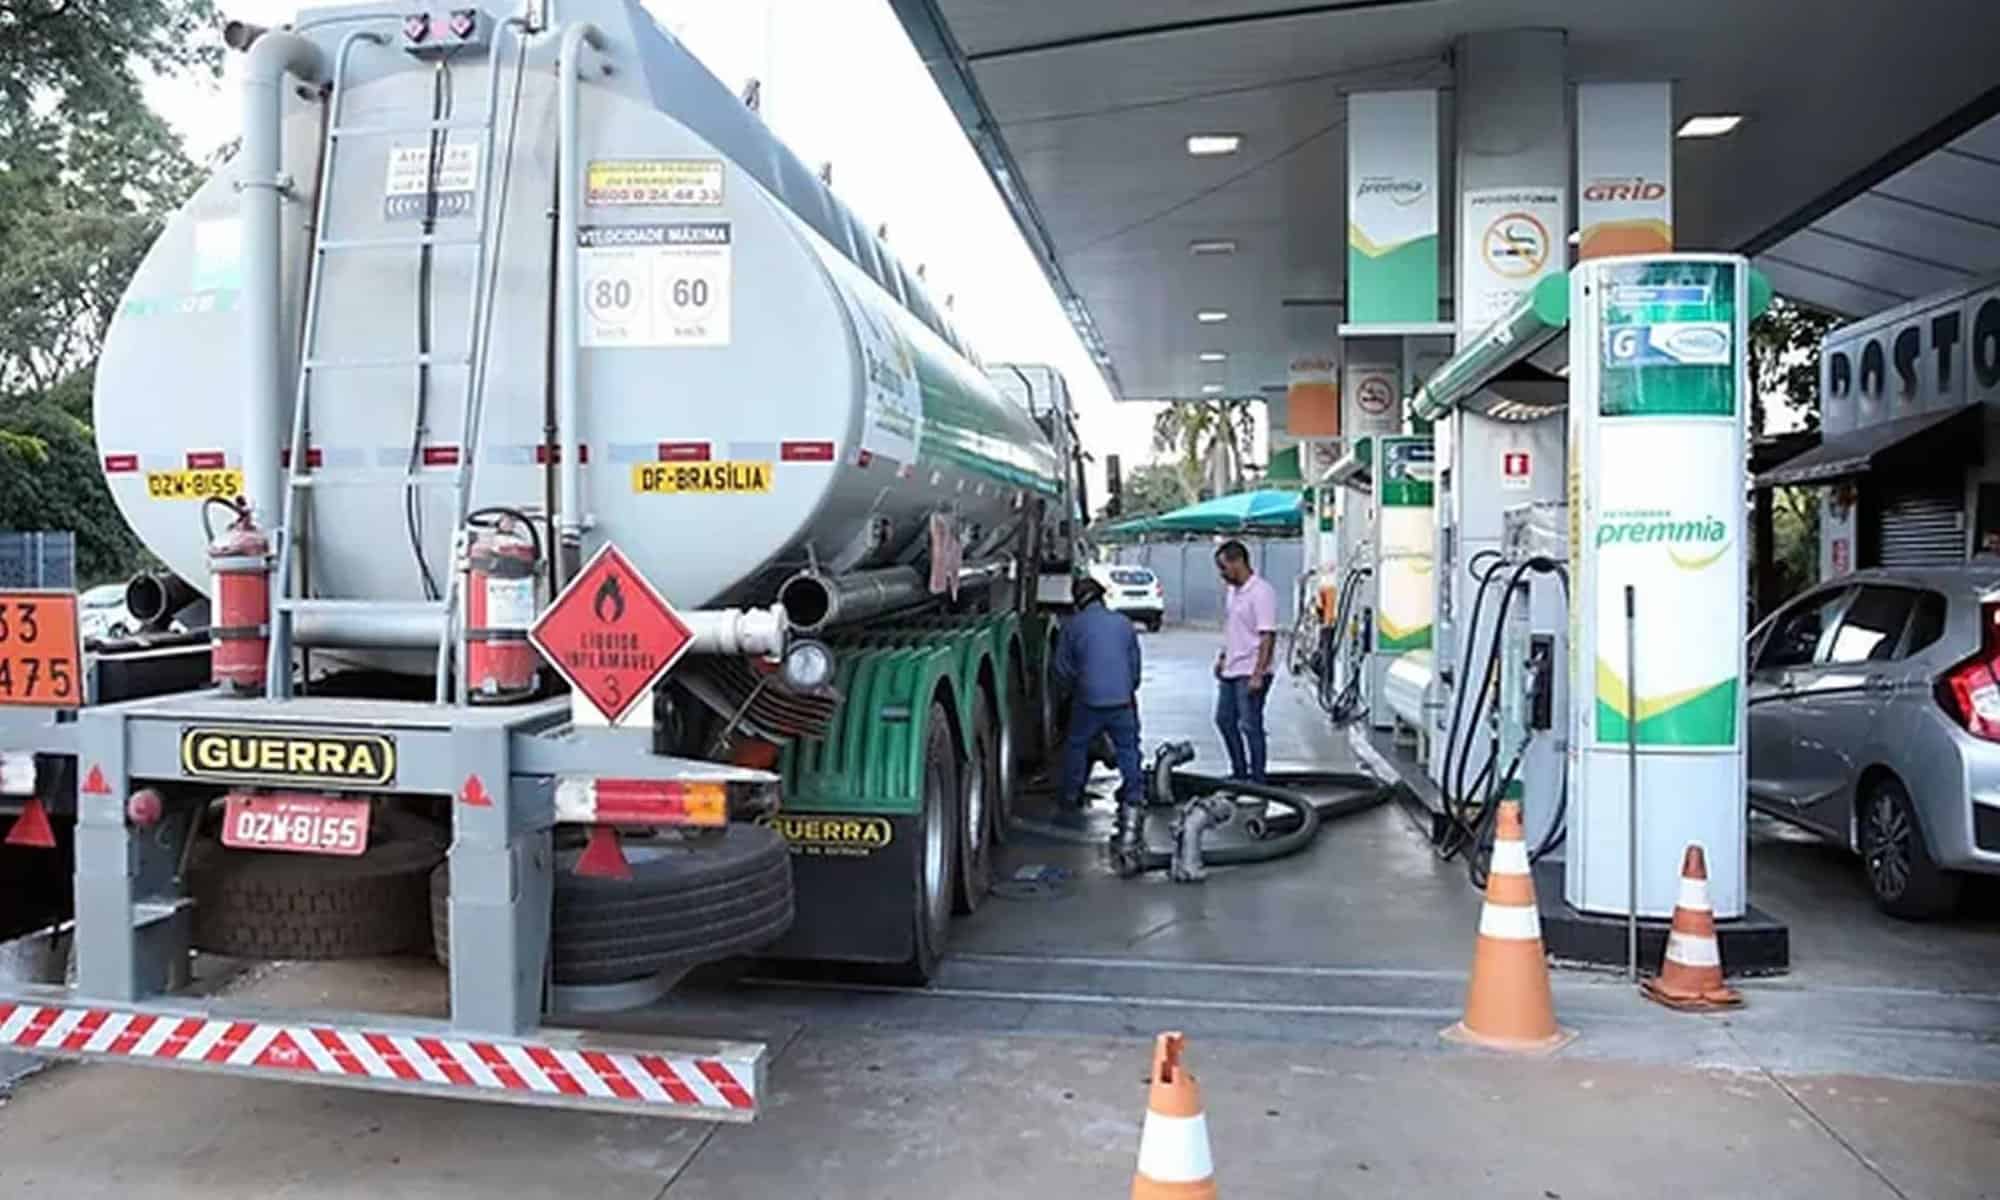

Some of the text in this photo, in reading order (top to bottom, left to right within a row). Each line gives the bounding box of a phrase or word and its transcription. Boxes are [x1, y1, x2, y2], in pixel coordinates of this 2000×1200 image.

[578, 225, 726, 245] VELOCIDADE MÁXIMA
[595, 279, 632, 309] 80
[672, 278, 708, 307] 60
[149, 473, 238, 496] OZW-8155
[642, 462, 764, 491] DF-BRASÍLIA
[1595, 514, 1726, 549] premmia
[603, 673, 622, 708] 3
[199, 736, 377, 776] GUERRA
[236, 811, 358, 848] OZW-8155
